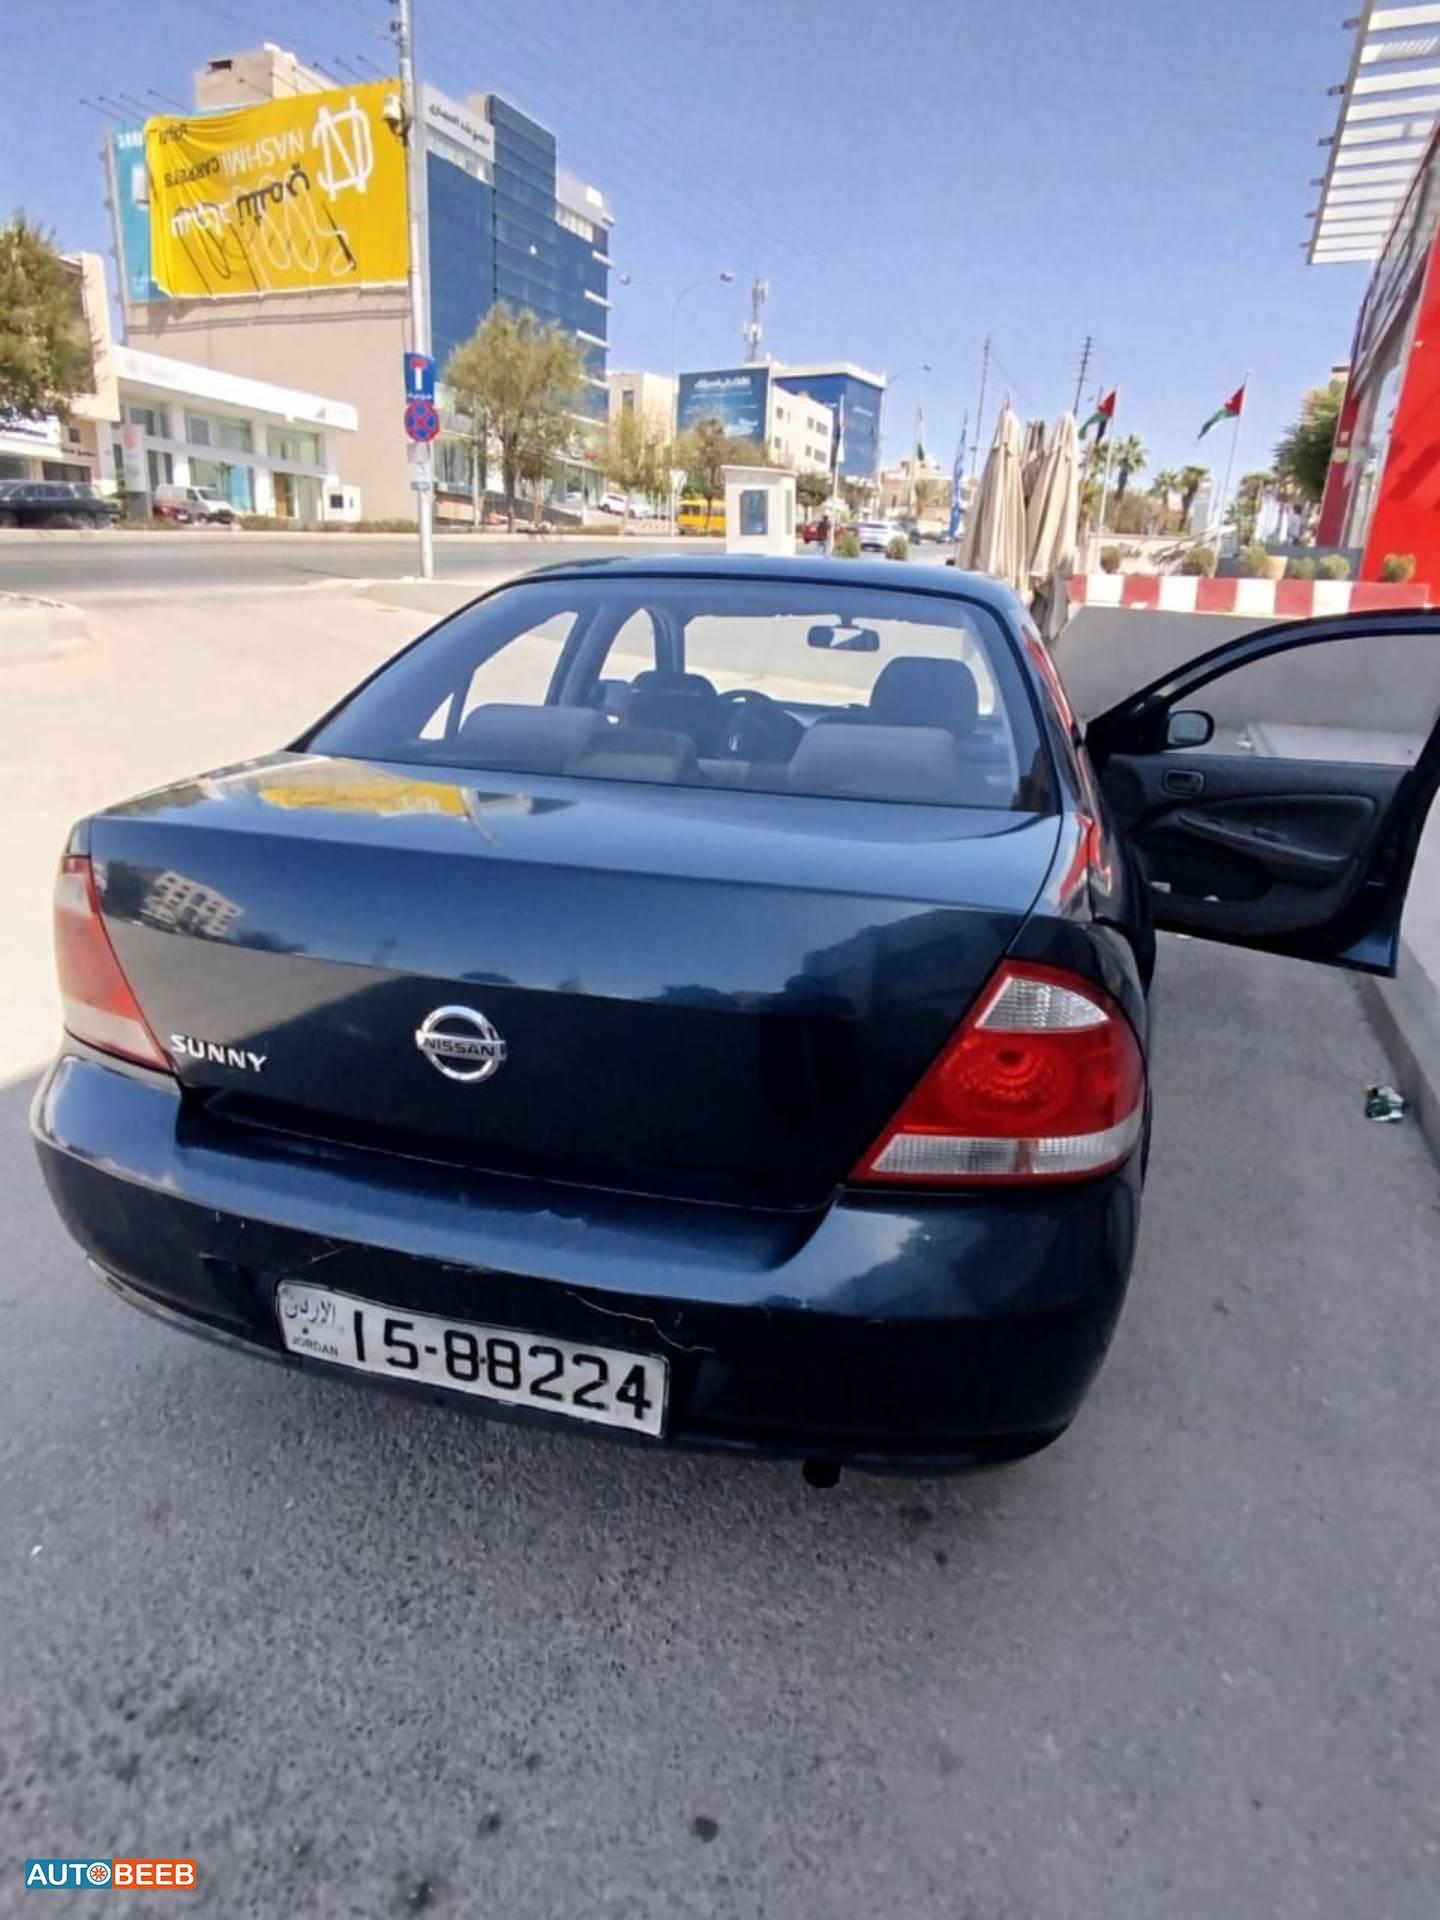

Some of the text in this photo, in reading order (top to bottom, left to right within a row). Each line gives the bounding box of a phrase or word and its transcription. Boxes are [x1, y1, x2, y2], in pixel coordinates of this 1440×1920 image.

[222, 127, 305, 176] NASHMI
[170, 1034, 268, 1073] SUNNY
[423, 1035, 496, 1059] NISSAN
[292, 1335, 339, 1358] JORDAN
